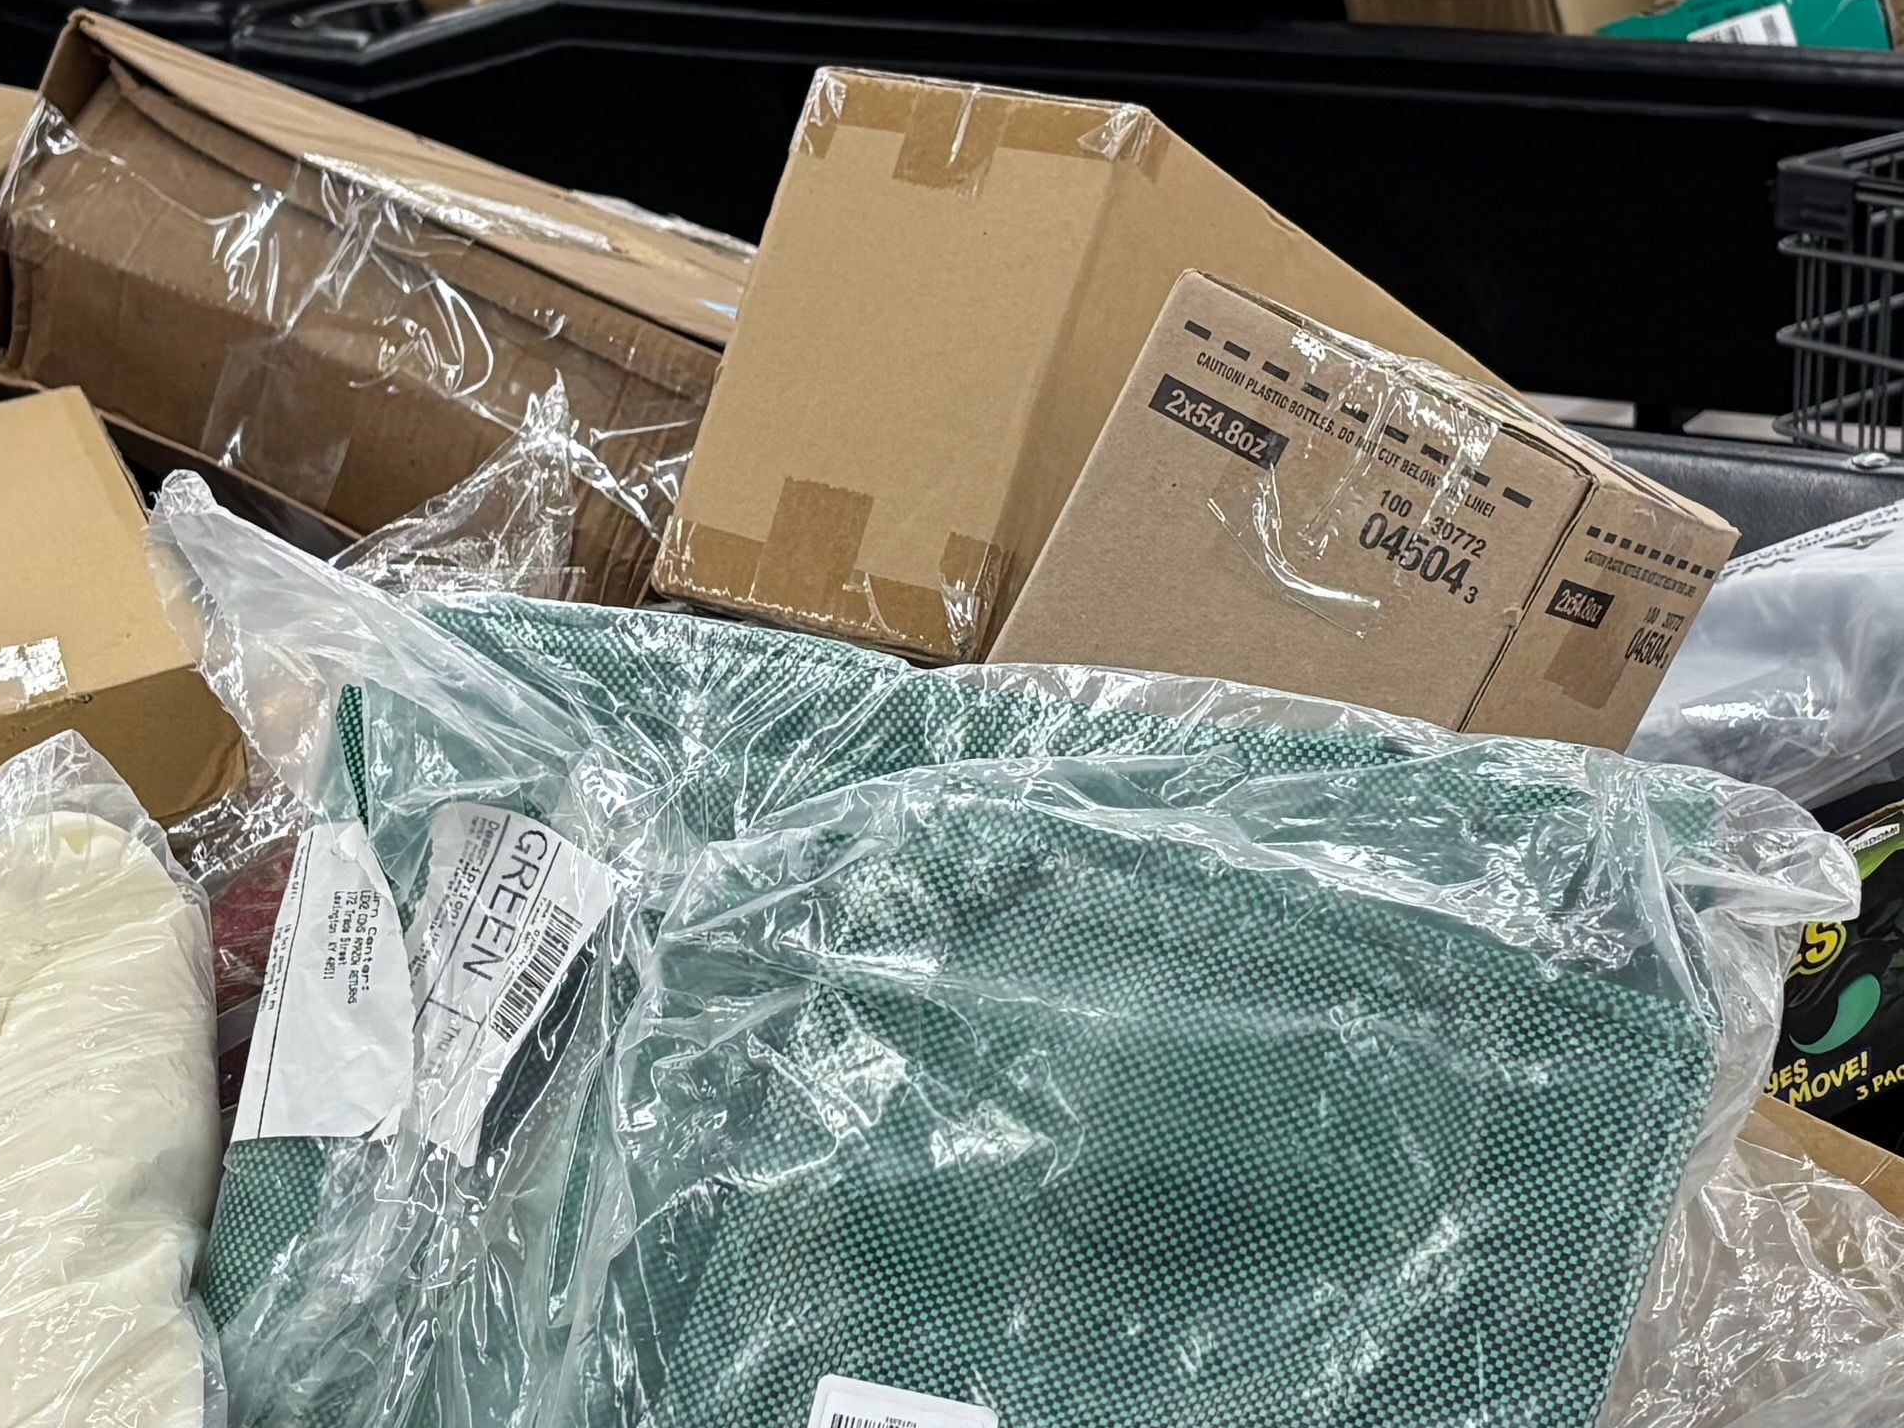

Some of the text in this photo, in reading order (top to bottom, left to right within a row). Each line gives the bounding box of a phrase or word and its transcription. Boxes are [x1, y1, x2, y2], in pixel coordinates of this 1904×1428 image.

[1164, 387, 1268, 460] 2x54.8oz
[1196, 351, 1247, 389] CAUTION!
[1246, 377, 1288, 411] PLASTIC
[1288, 399, 1335, 438] BOTTLES,
[1337, 426, 1355, 445] DO
[1378, 445, 1400, 470] CUT
[1400, 457, 1438, 490] BELOW
[1464, 493, 1496, 519] LINE!
[1358, 512, 1479, 605] 04504 3
[1379, 489, 1487, 560] 100 30772
[1624, 627, 1673, 665] 04504
[329, 890, 345, 935] Lexington
[337, 890, 358, 966] 172 Trade Street
[463, 827, 549, 982] GREEN
[360, 925, 379, 992] Center:
[1768, 1050, 1870, 1107] YES MOVE!
[1855, 1084, 1869, 1102] 3
